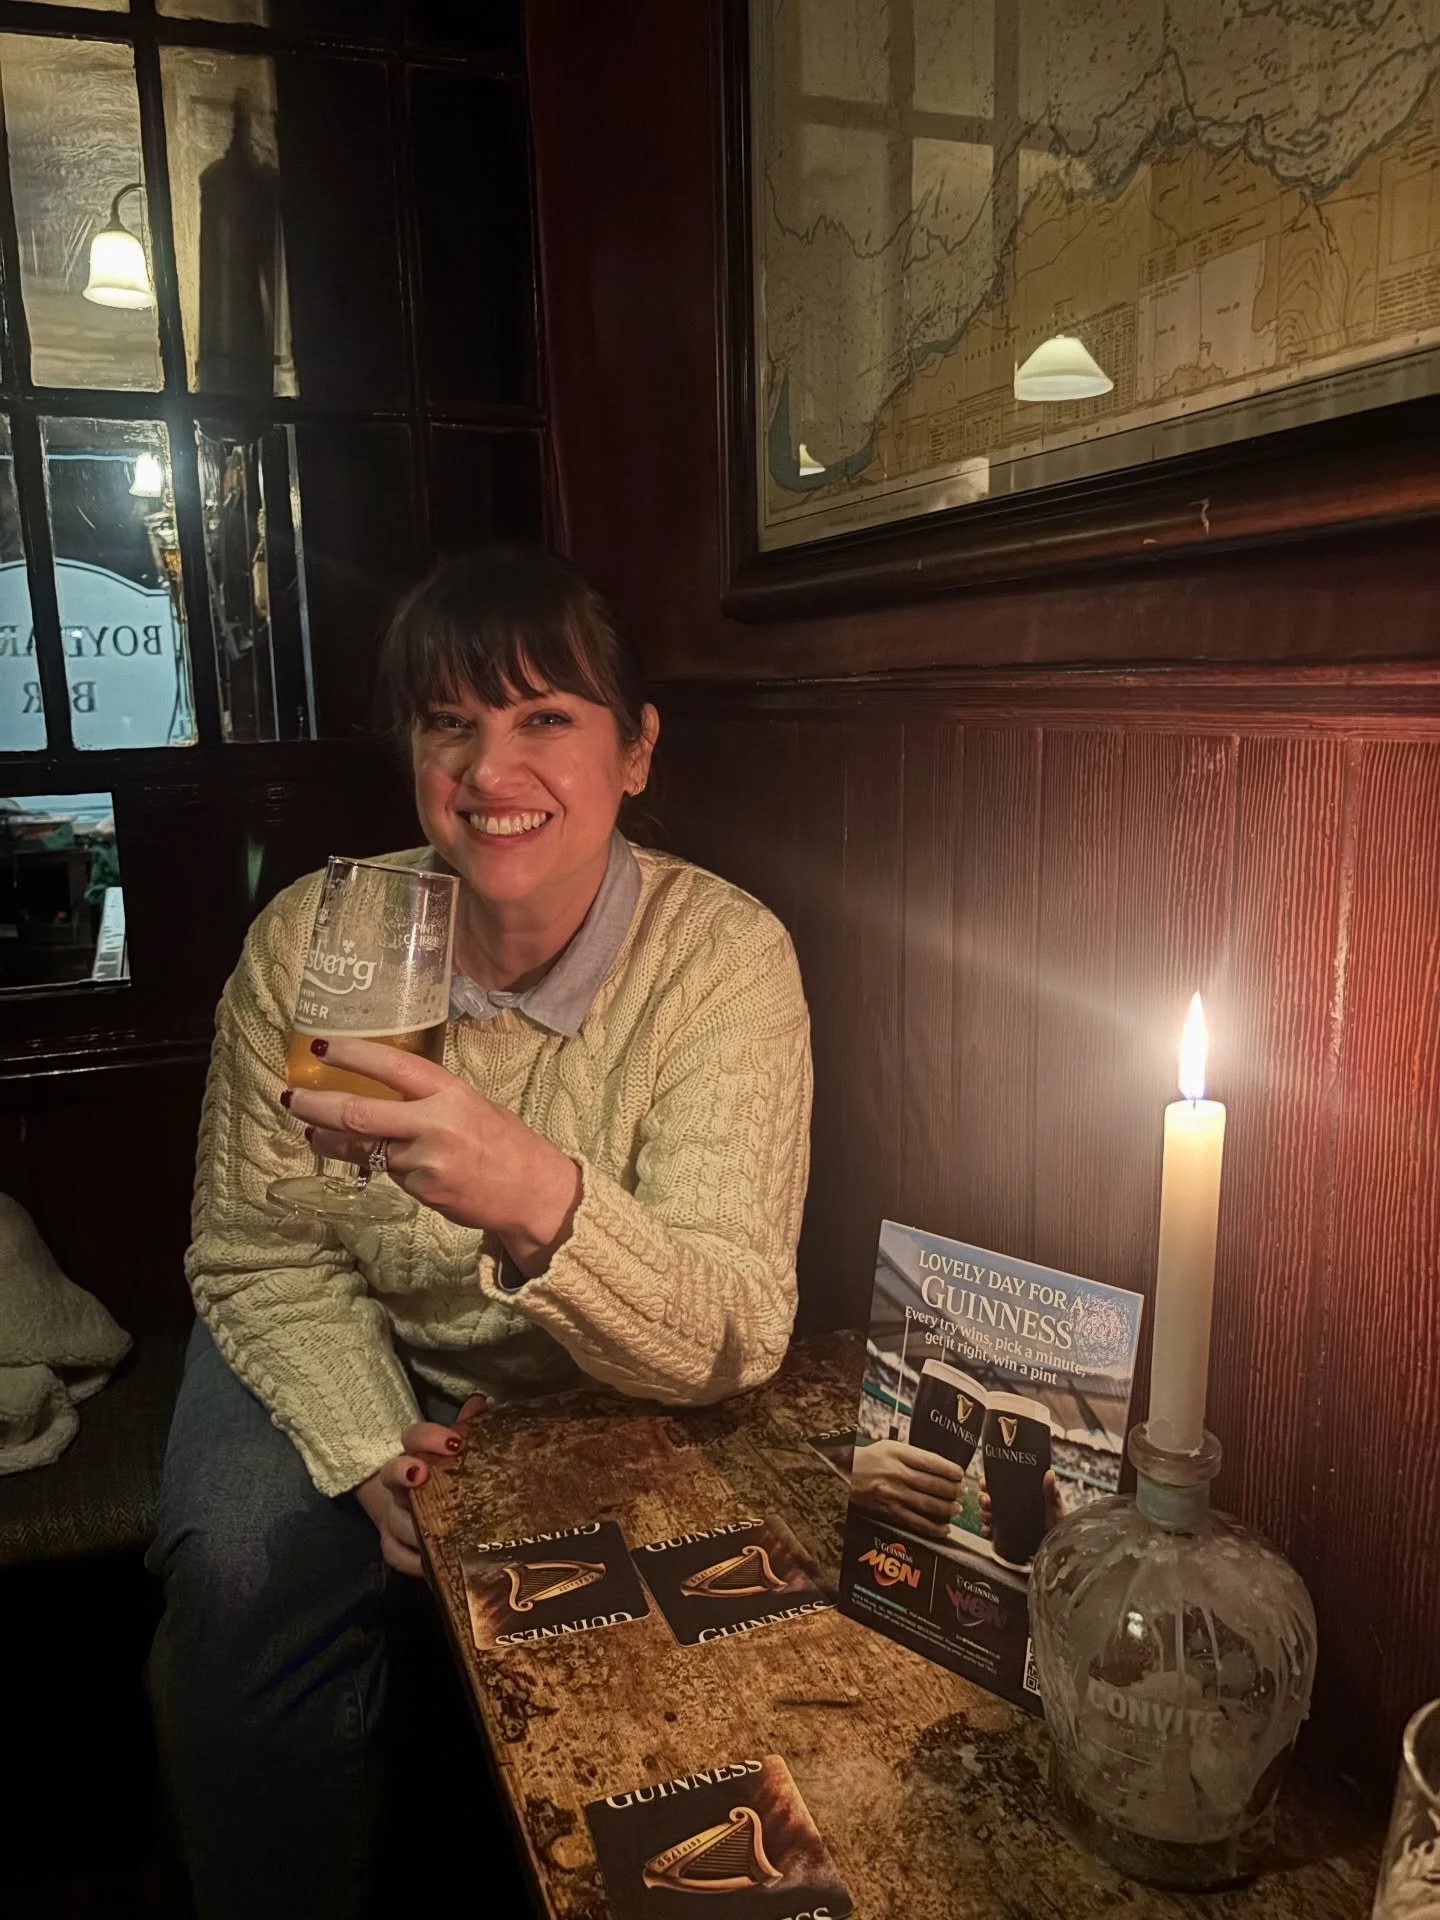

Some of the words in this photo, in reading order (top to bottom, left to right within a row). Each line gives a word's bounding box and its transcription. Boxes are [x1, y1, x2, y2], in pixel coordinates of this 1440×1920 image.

[306, 939, 377, 991] sberg
[298, 1000, 329, 1019] SNER
[919, 1250, 985, 1284] LOVELY
[988, 1271, 1026, 1296] DAY
[1028, 1283, 1067, 1309] FOR
[1069, 1297, 1085, 1316] A
[921, 1275, 1073, 1350] GUINNESS
[905, 1305, 938, 1328] Every
[939, 1317, 959, 1337] try
[960, 1325, 993, 1347] wins,
[995, 1337, 1023, 1356] pick
[1024, 1347, 1033, 1358] a
[1035, 1350, 1087, 1378] minute,
[924, 1331, 944, 1346] get
[946, 1335, 955, 1349] it
[957, 1341, 991, 1364] right,
[993, 1353, 1017, 1371] win
[1019, 1363, 1028, 1375] a
[1030, 1366, 1058, 1385] pint
[930, 1408, 977, 1447] GUINNESS
[985, 1444, 1037, 1466] GUINNESS
[963, 1580, 1000, 1604] GUINNESS
[606, 1759, 763, 1809] GUINNESS
